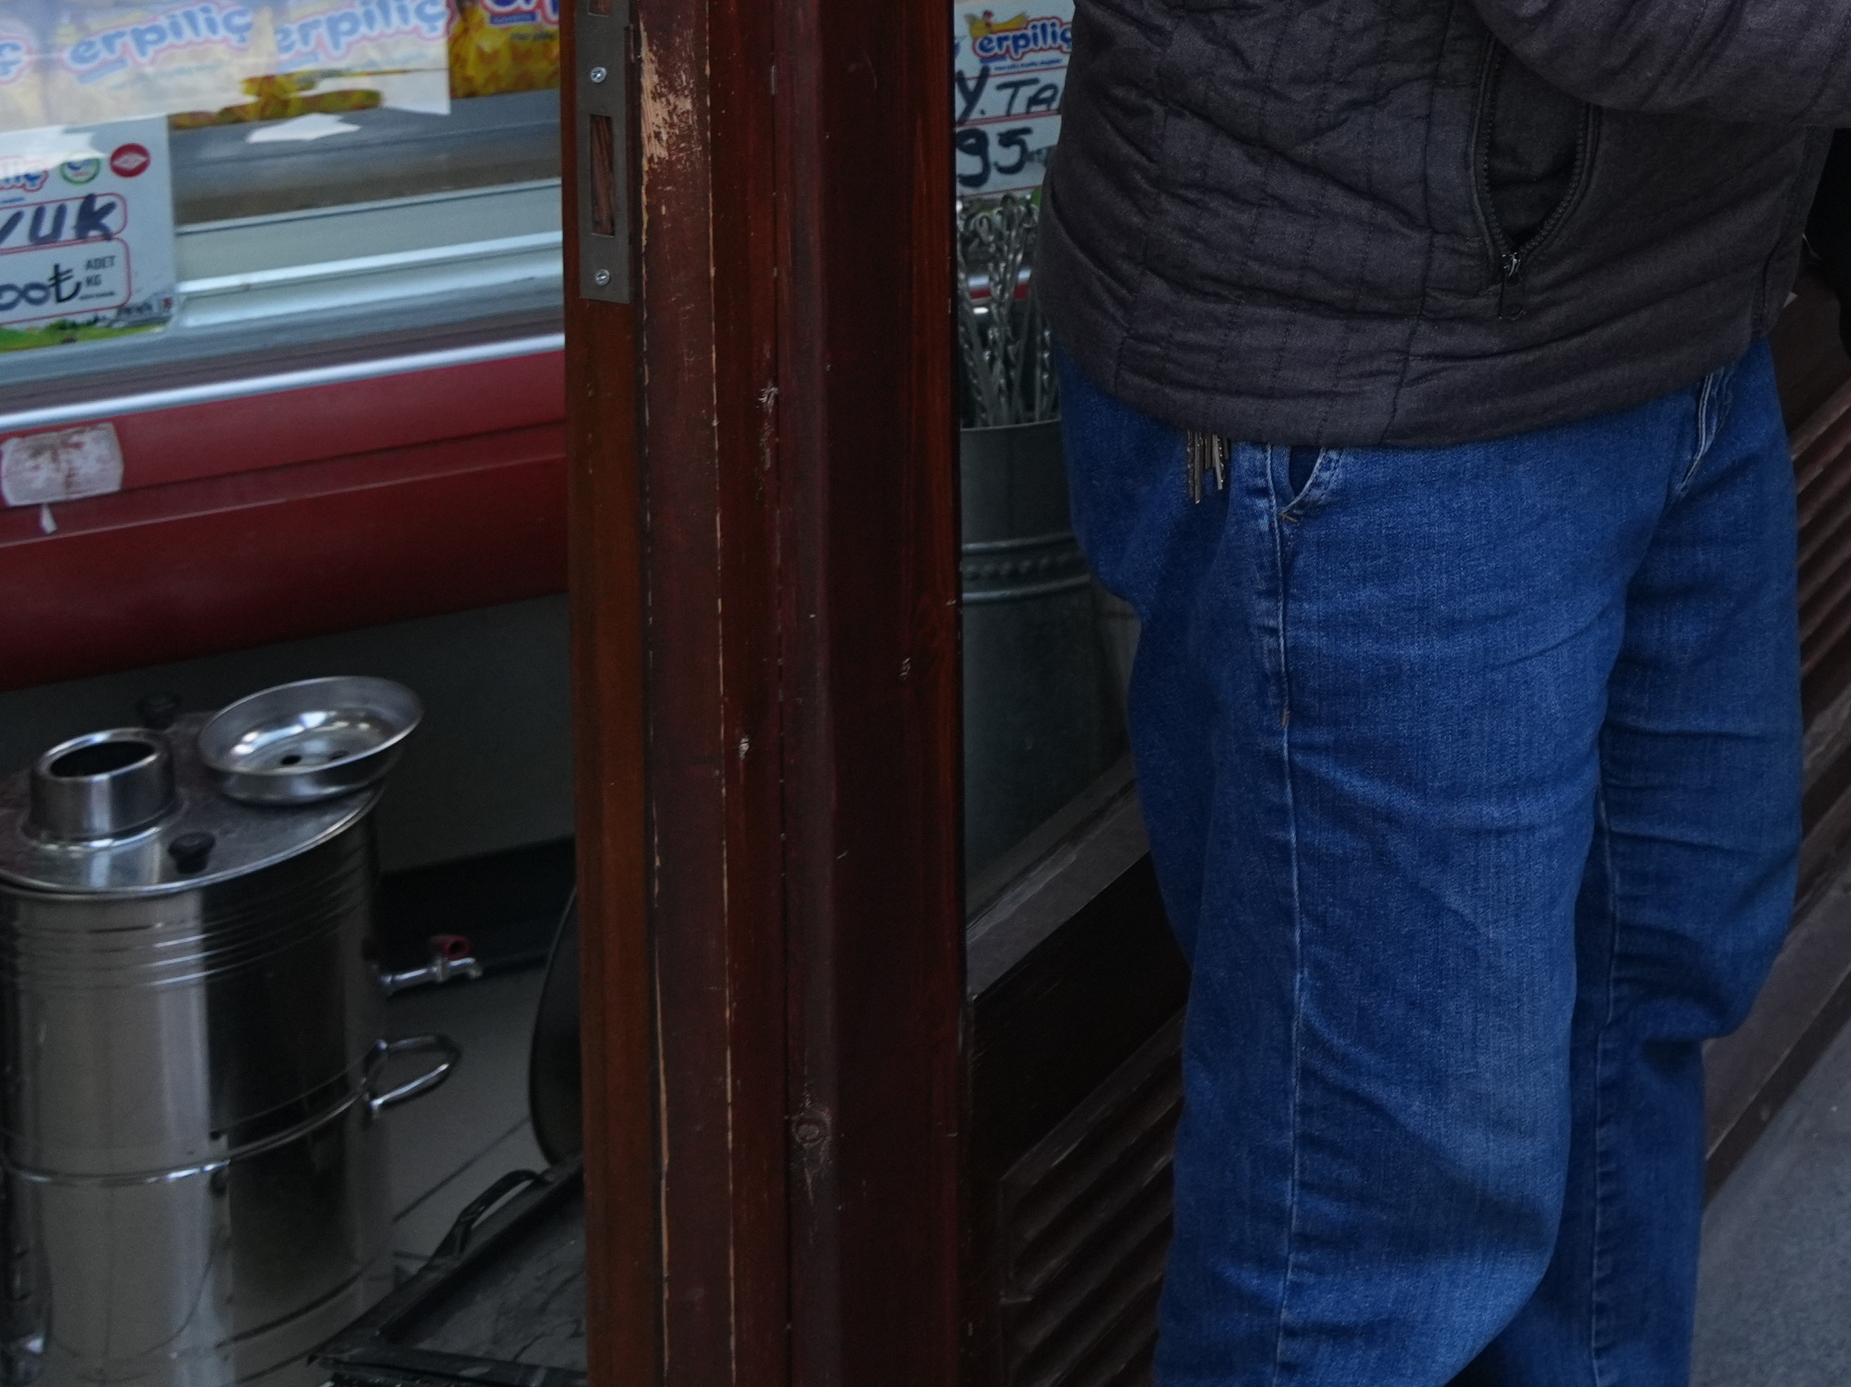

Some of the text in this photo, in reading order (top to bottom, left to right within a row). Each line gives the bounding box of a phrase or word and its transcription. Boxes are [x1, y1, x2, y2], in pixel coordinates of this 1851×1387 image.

[69, 4, 254, 65] erpiliç
[84, 254, 117, 270] ADET
[85, 273, 103, 288] KG
